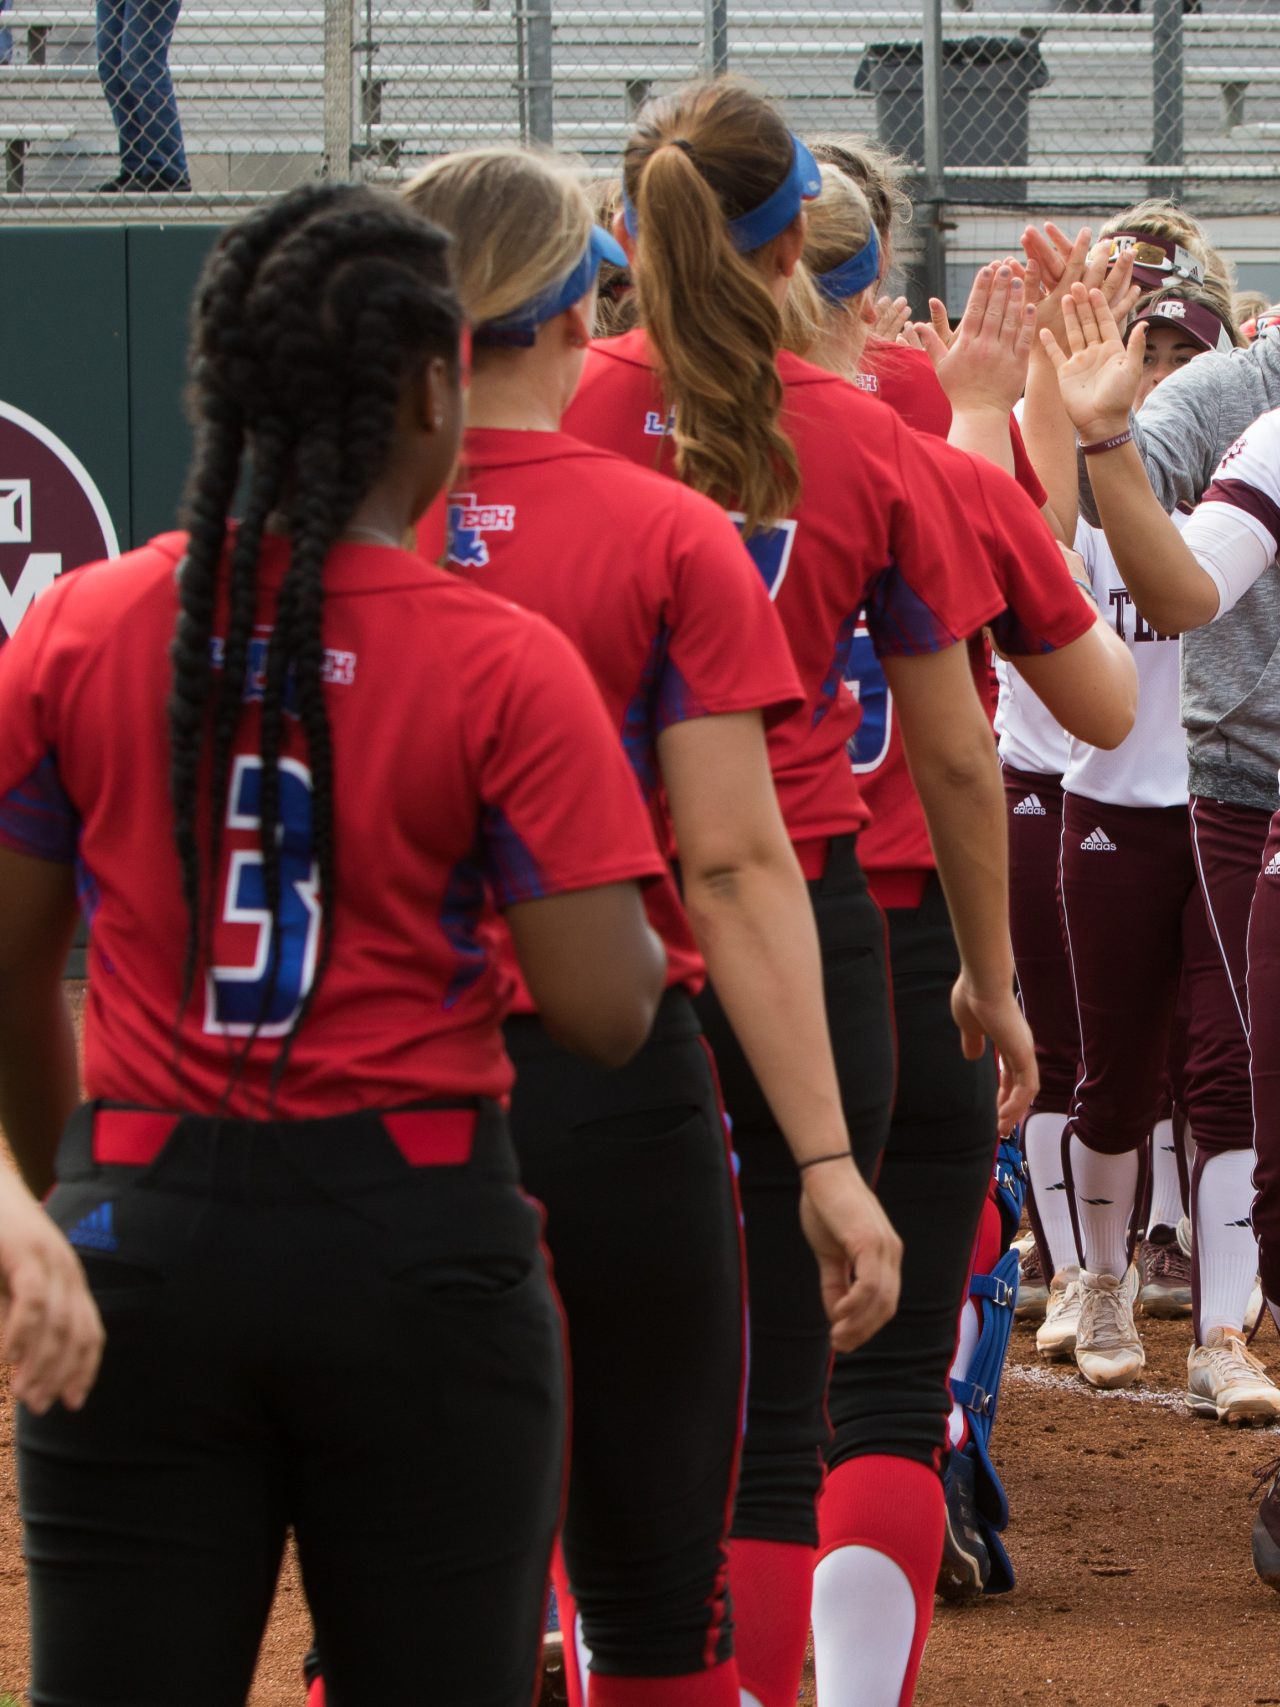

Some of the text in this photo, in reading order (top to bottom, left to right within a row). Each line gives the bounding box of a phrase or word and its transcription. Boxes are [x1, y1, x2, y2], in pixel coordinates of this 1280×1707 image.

[1013, 804, 1046, 816] adidas
[1080, 839, 1117, 851] adidas
[202, 754, 325, 1038] 3
